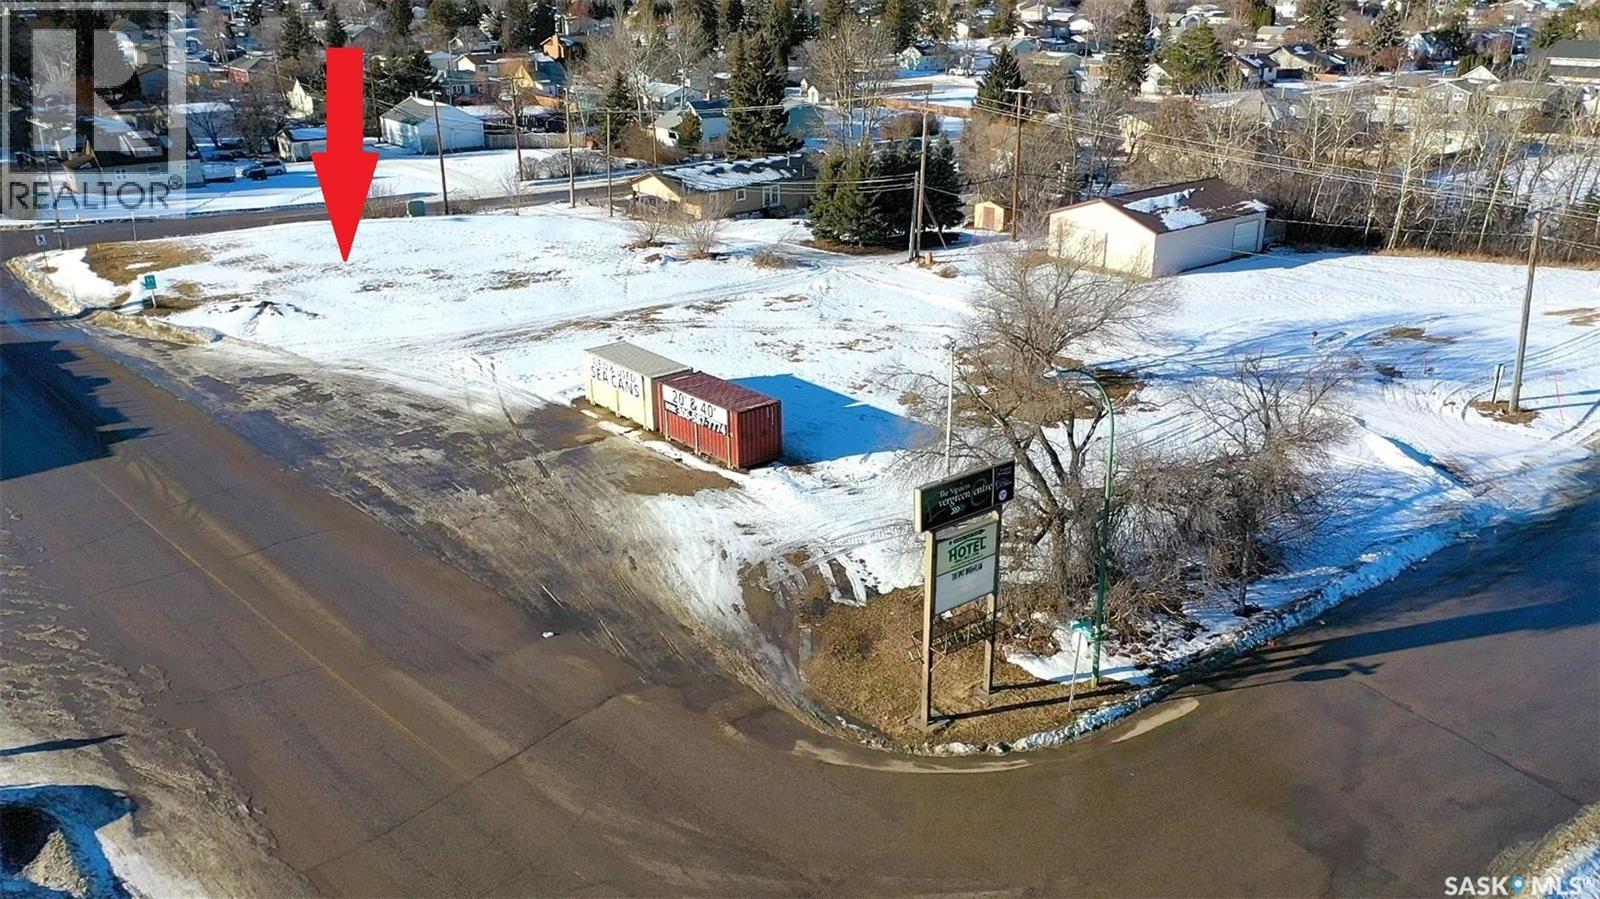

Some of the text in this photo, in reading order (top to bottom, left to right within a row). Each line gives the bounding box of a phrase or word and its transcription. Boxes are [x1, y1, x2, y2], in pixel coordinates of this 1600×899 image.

[591, 365, 640, 398] SEA CANS
[690, 398, 698, 411] &
[948, 536, 987, 563] HOTEL
